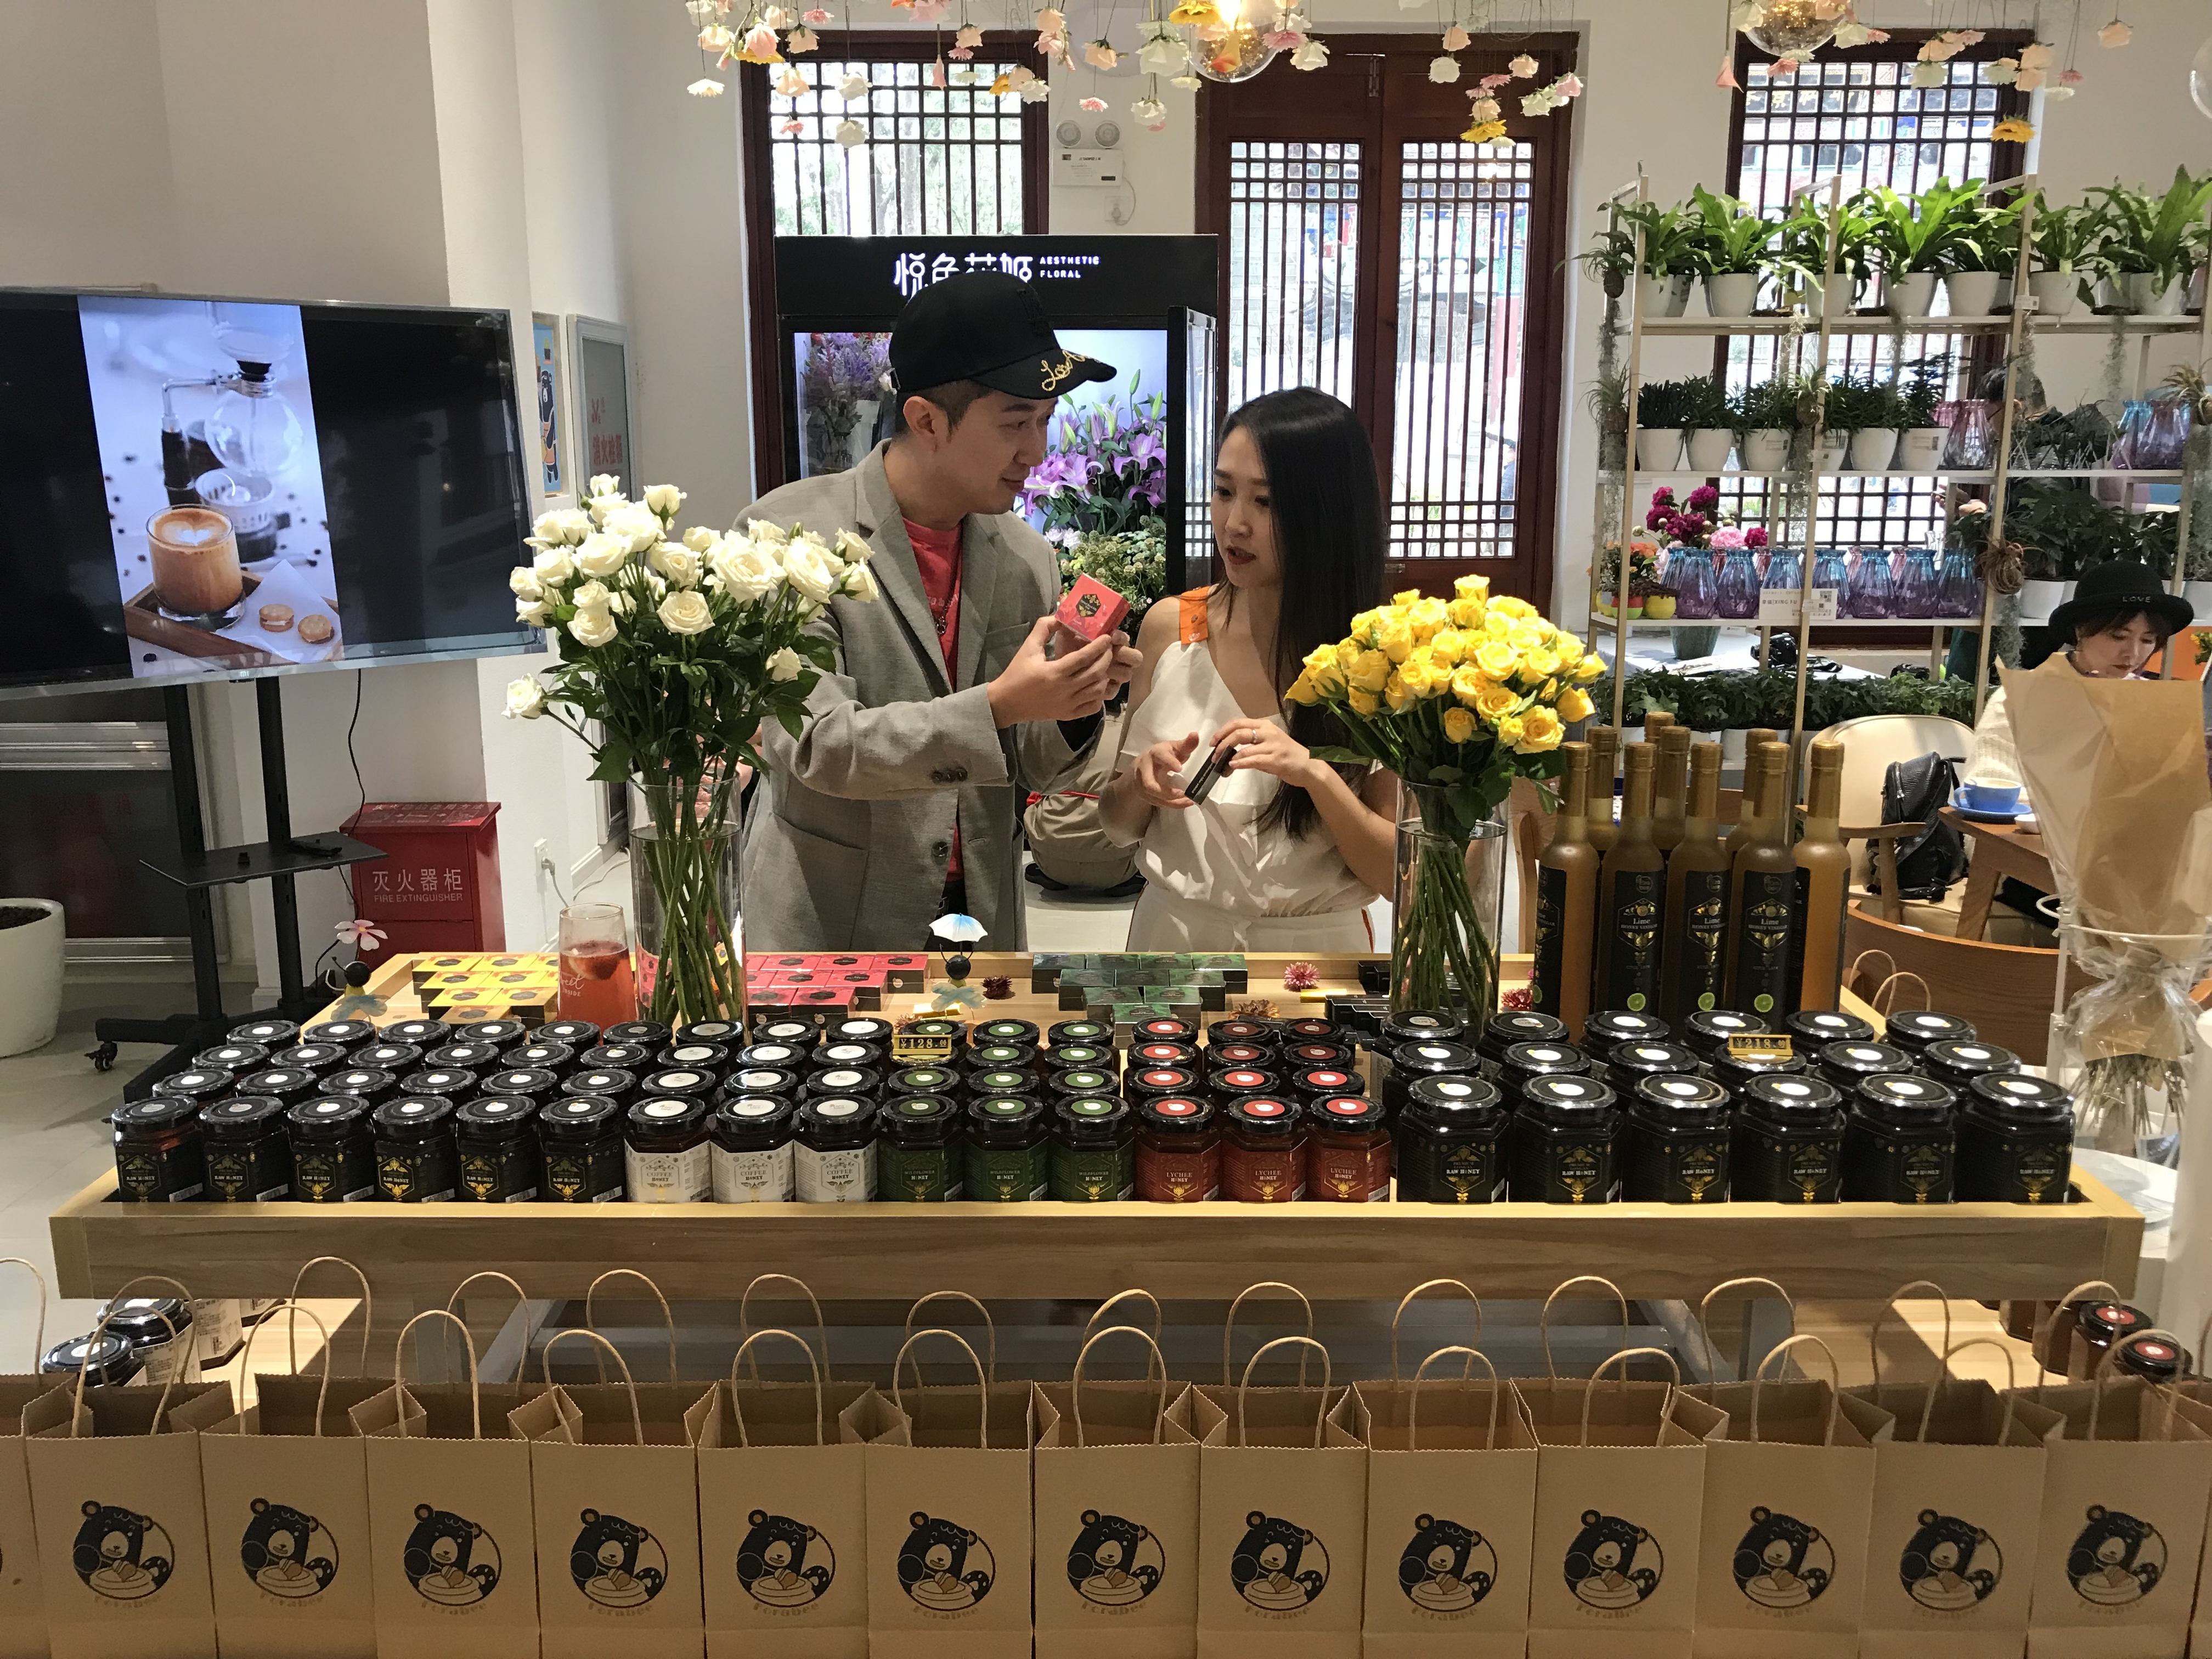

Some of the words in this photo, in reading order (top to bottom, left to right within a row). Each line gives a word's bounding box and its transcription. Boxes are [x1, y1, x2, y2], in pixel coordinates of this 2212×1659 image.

[1040, 256, 1099, 265] AESTHETIC
[1040, 269, 1081, 278] FLORAL
[373, 868, 463, 892] 灭火器柜
[374, 894, 394, 902] FIRE
[396, 893, 463, 902] EXTINGUISHER
